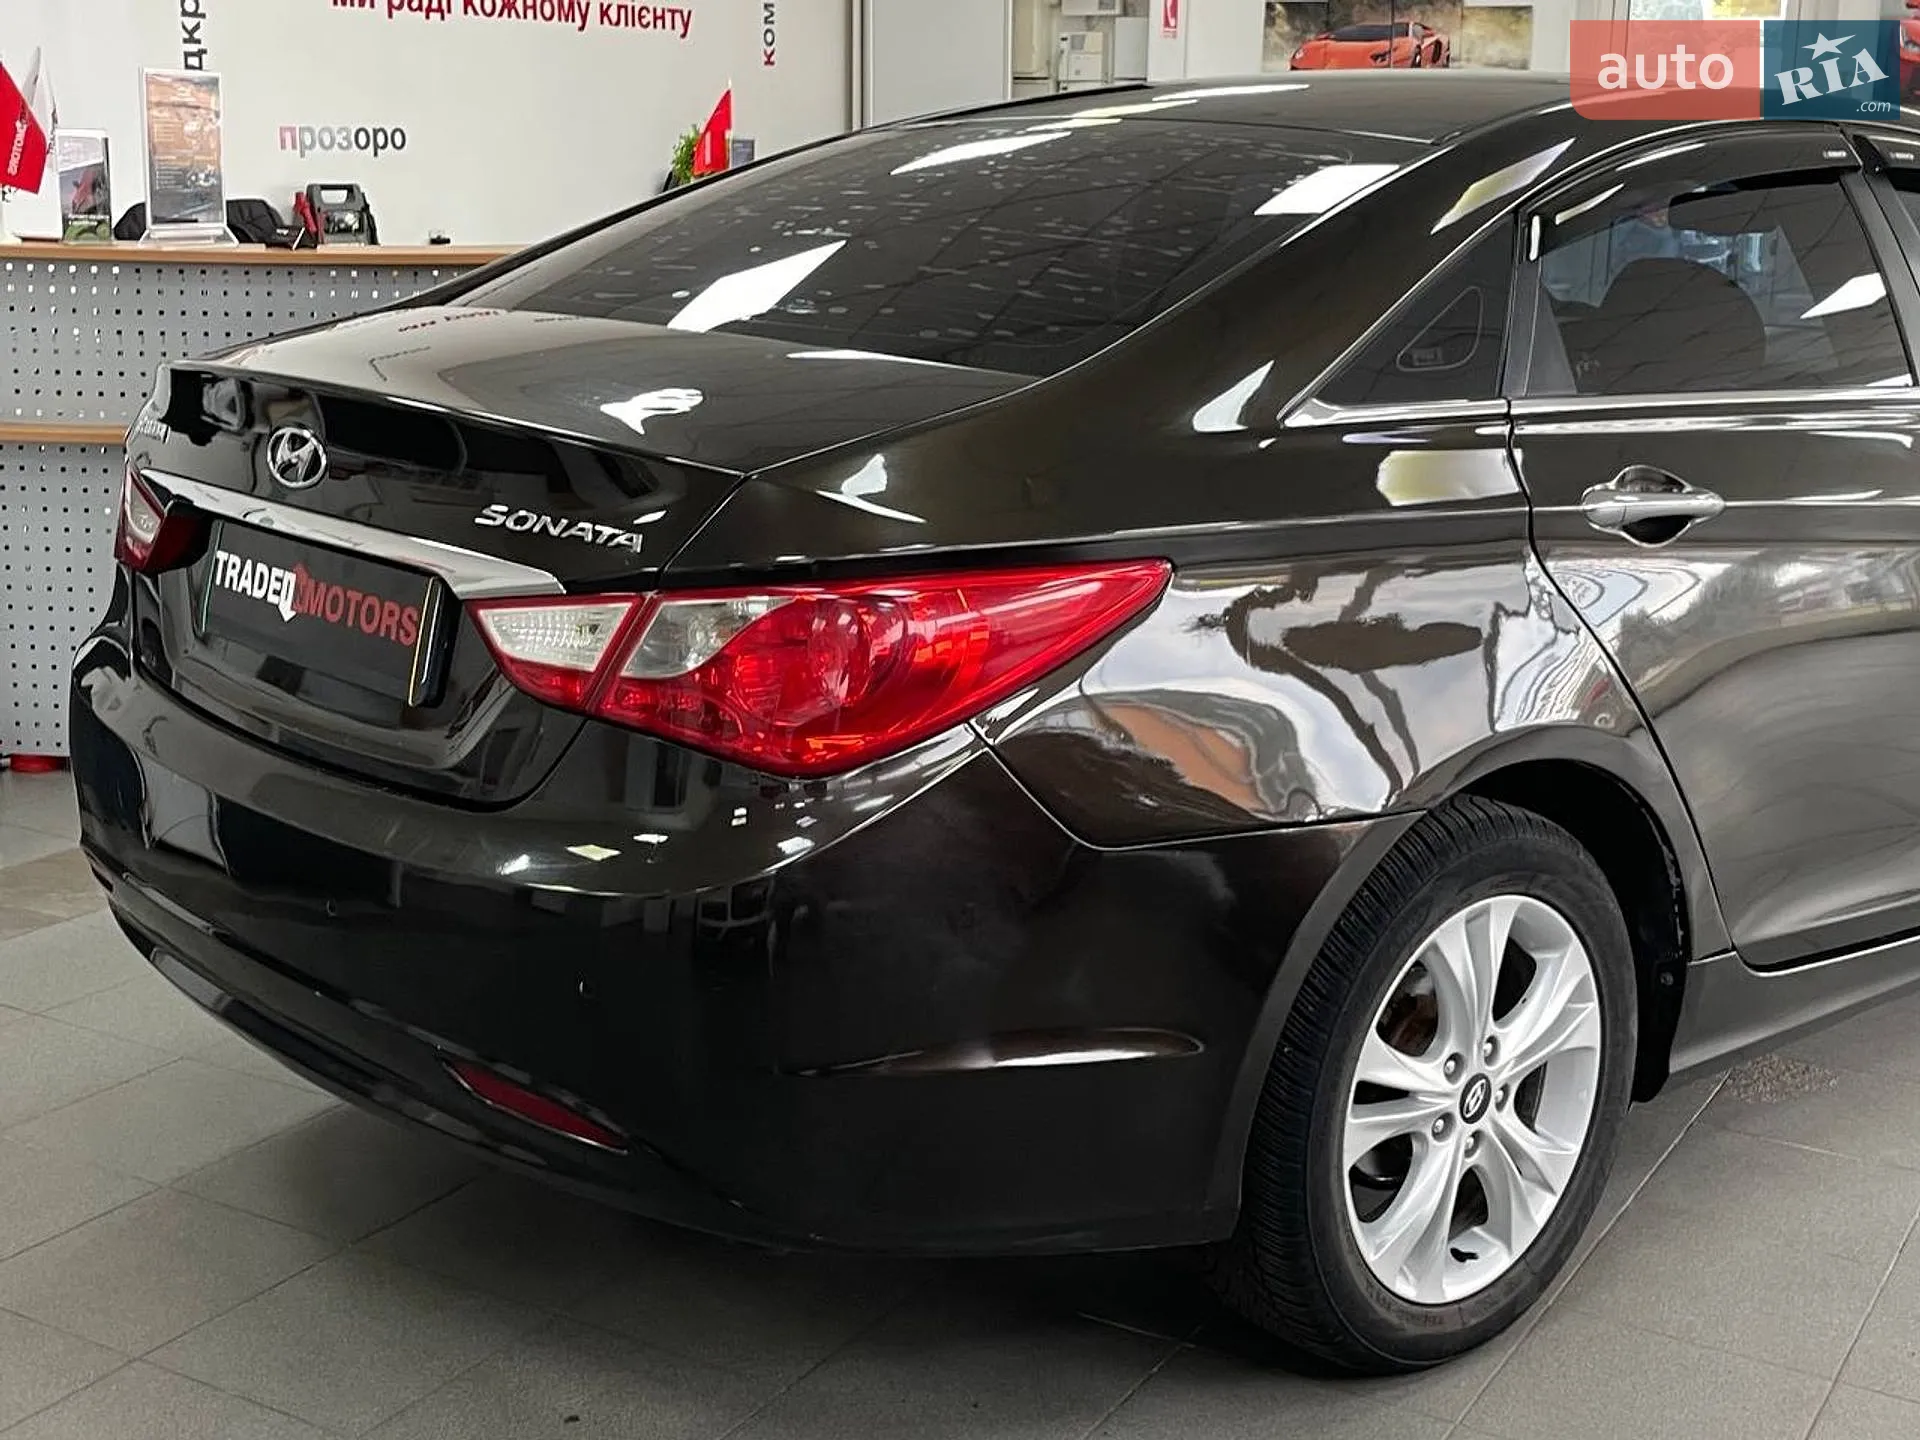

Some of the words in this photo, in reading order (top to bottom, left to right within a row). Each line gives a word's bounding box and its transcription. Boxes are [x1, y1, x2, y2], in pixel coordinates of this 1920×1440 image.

[463, 0, 591, 32] кожному
[600, 0, 692, 39] клієнту
[279, 126, 407, 158] прозоро
[474, 504, 643, 553] SONATA
[306, 579, 419, 647] MOTORS
